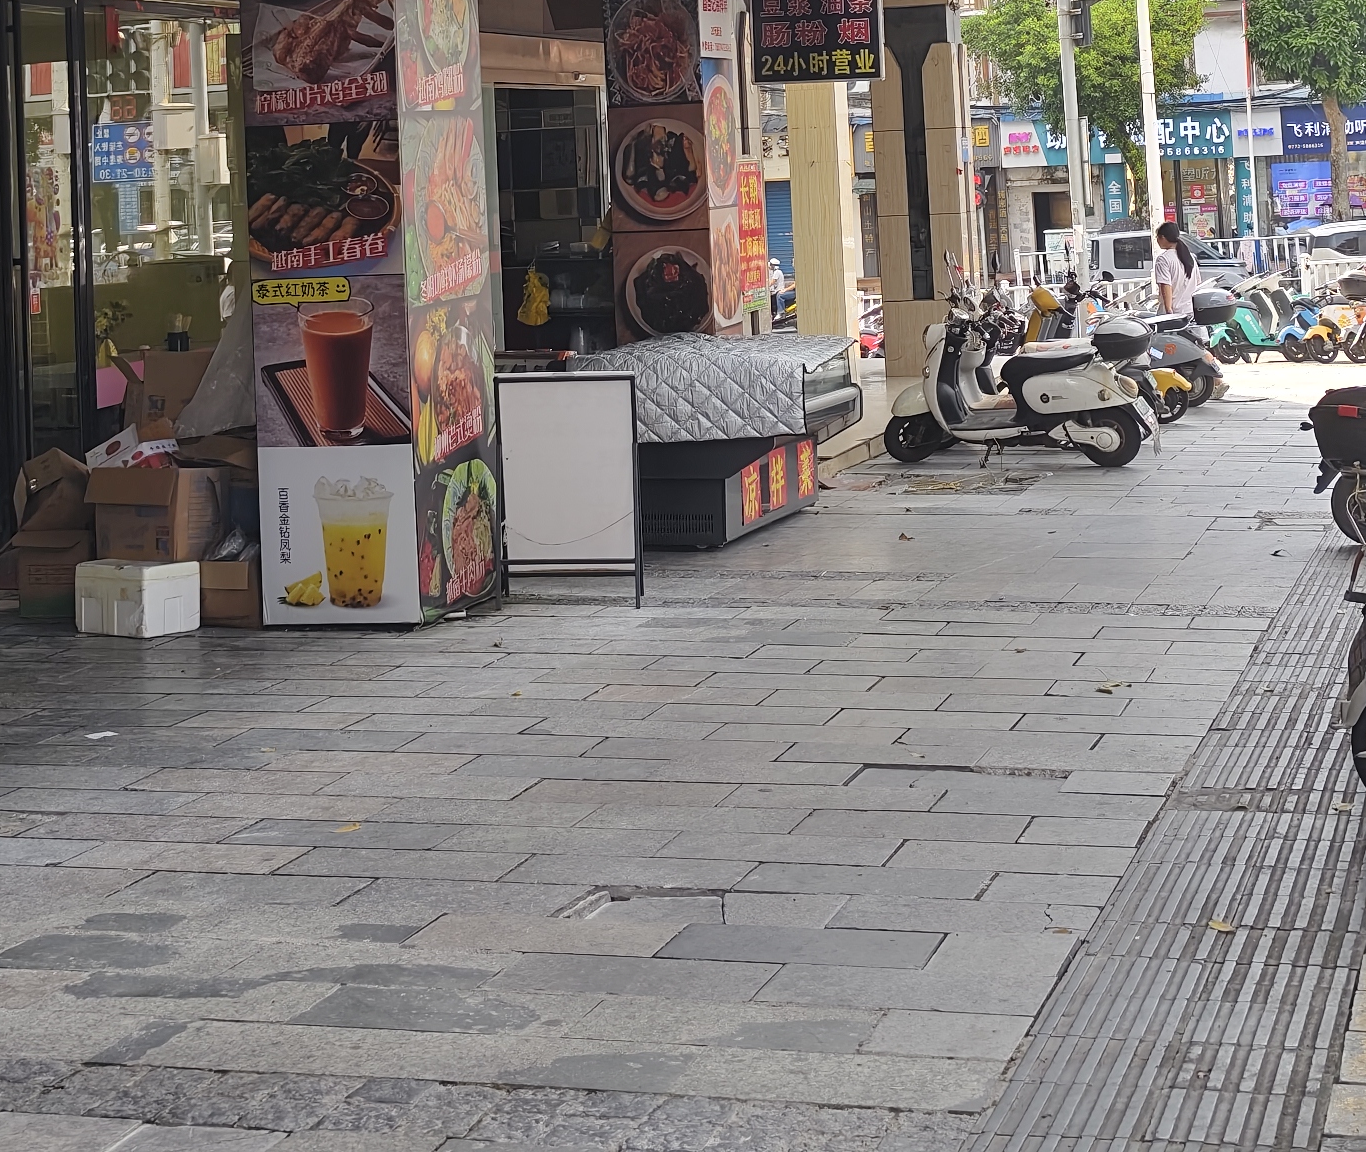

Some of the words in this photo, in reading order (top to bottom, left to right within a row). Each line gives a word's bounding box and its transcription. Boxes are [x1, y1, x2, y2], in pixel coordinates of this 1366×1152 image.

[761, 19, 828, 48] 肠粉
[838, 18, 870, 44] 烟
[761, 49, 875, 75] 24小时营业
[271, 233, 385, 271] 越南手工春卷
[256, 281, 330, 299] 泰式红奶茶
